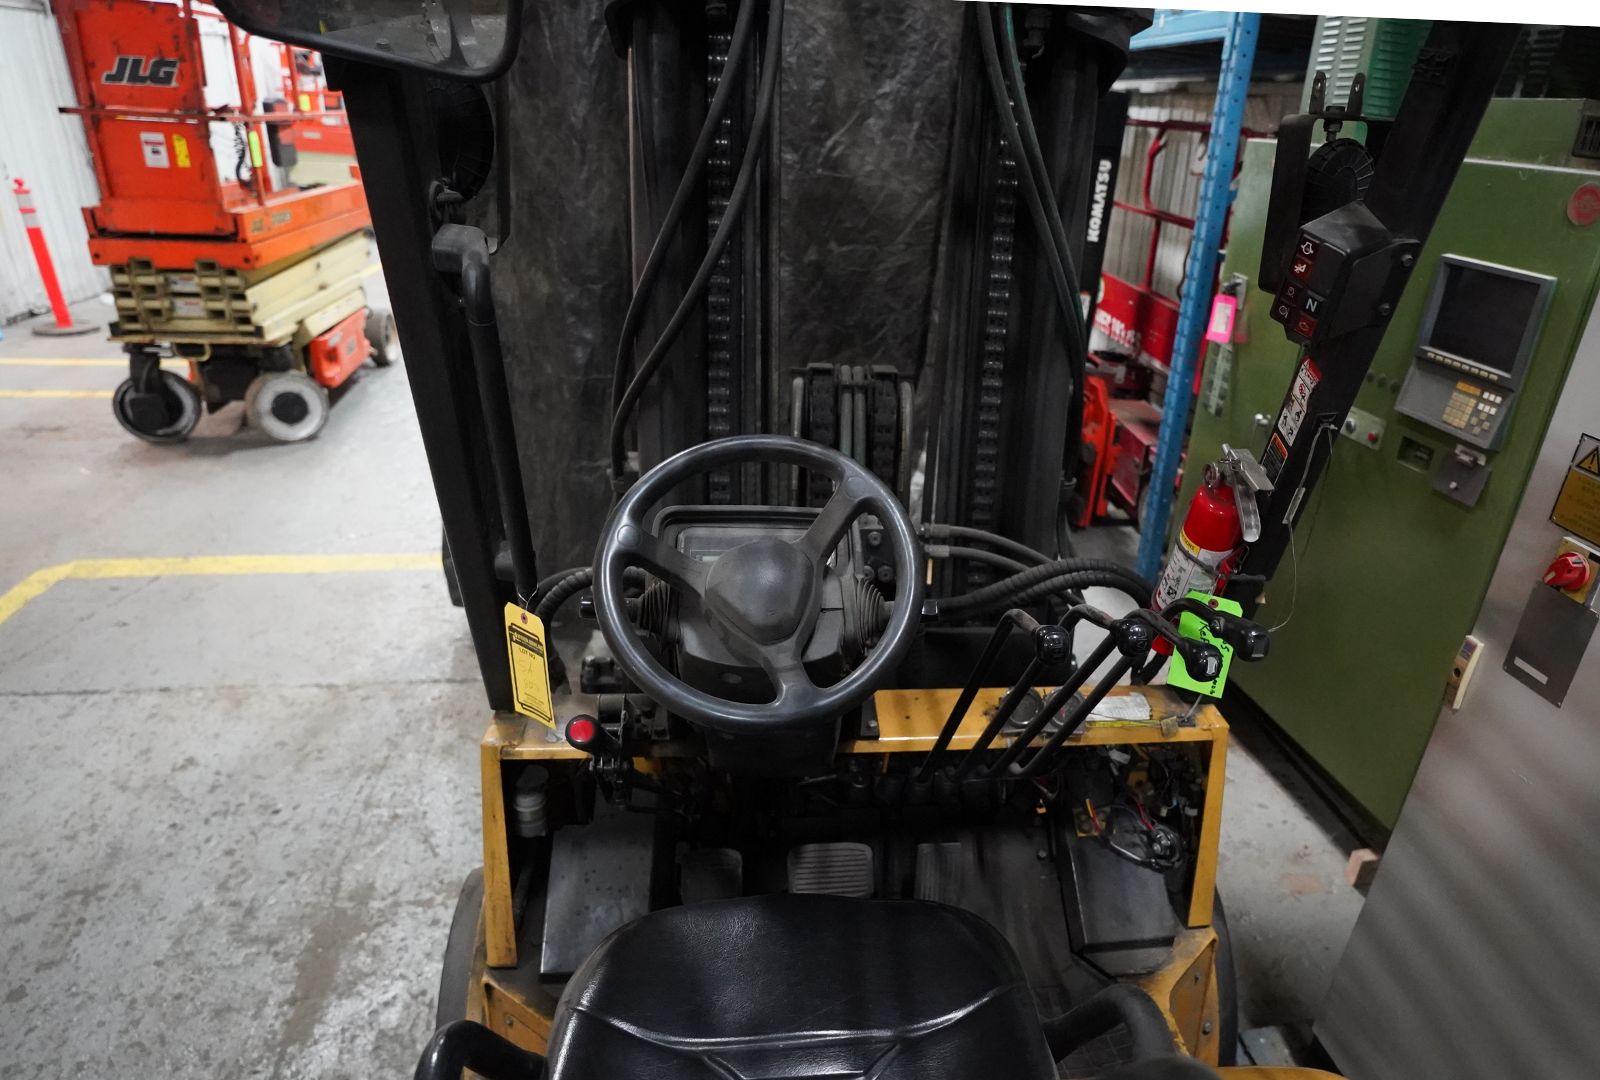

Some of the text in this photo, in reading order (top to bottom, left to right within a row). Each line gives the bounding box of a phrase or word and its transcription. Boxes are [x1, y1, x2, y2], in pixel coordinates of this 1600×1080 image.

[103, 57, 179, 87] JLG
[1087, 160, 1112, 242] KOMATSU
[1306, 298, 1318, 313] N
